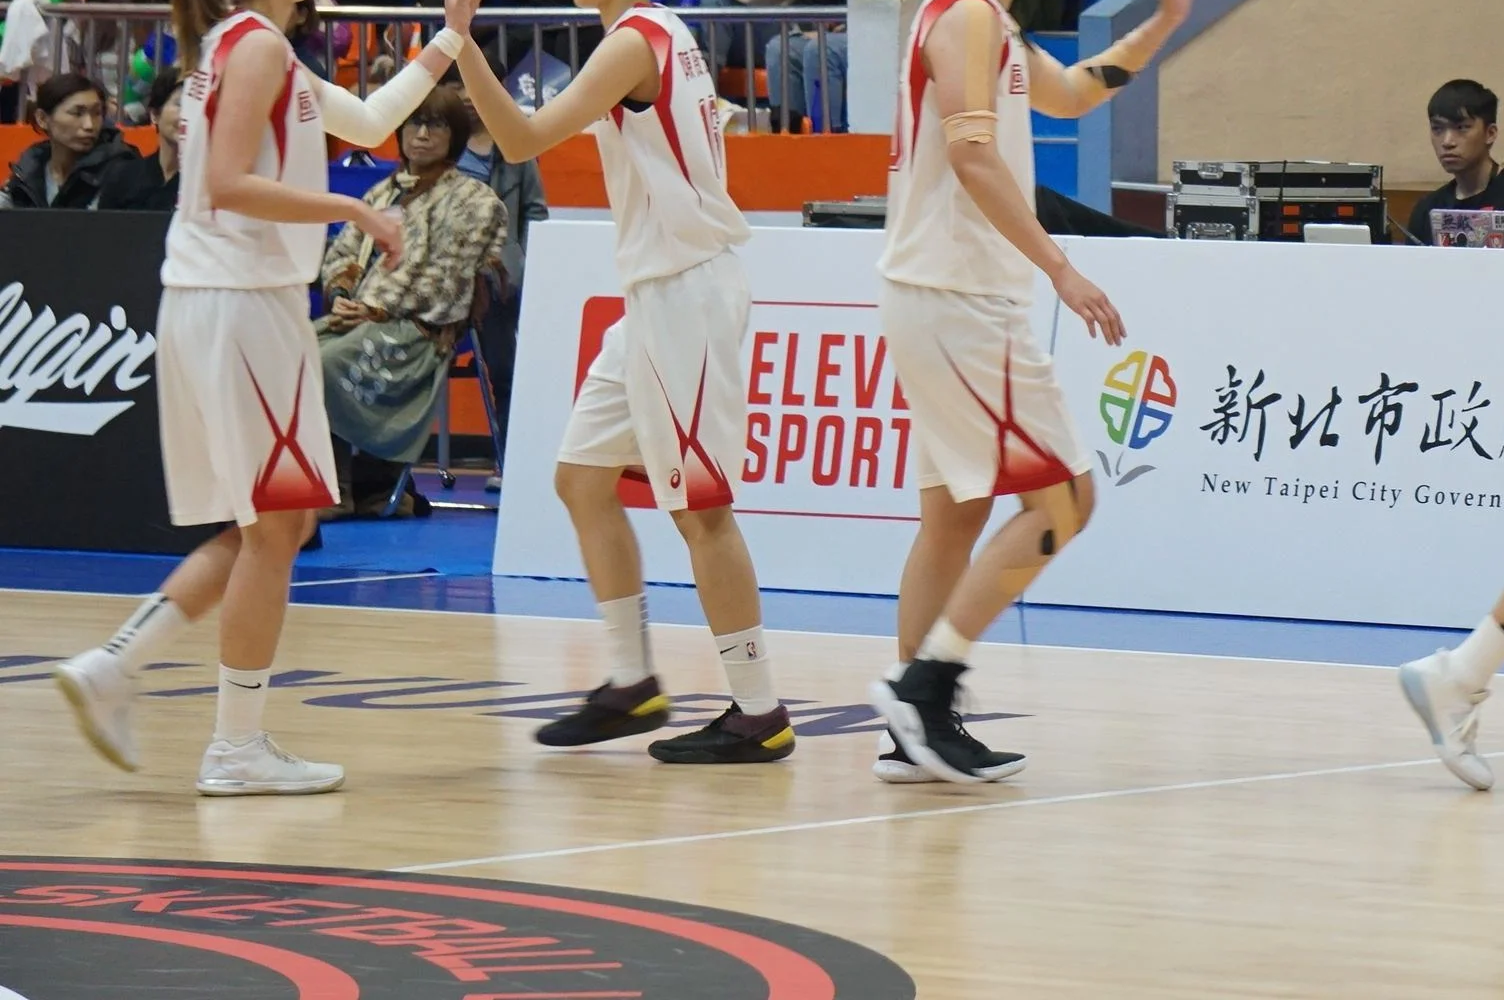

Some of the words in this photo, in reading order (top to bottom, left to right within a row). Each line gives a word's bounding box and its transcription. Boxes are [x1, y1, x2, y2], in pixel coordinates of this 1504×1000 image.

[747, 331, 911, 410] ELEV
[1201, 473, 1252, 495] New
[1264, 476, 1340, 504] Taipei
[1352, 480, 1402, 508] City
